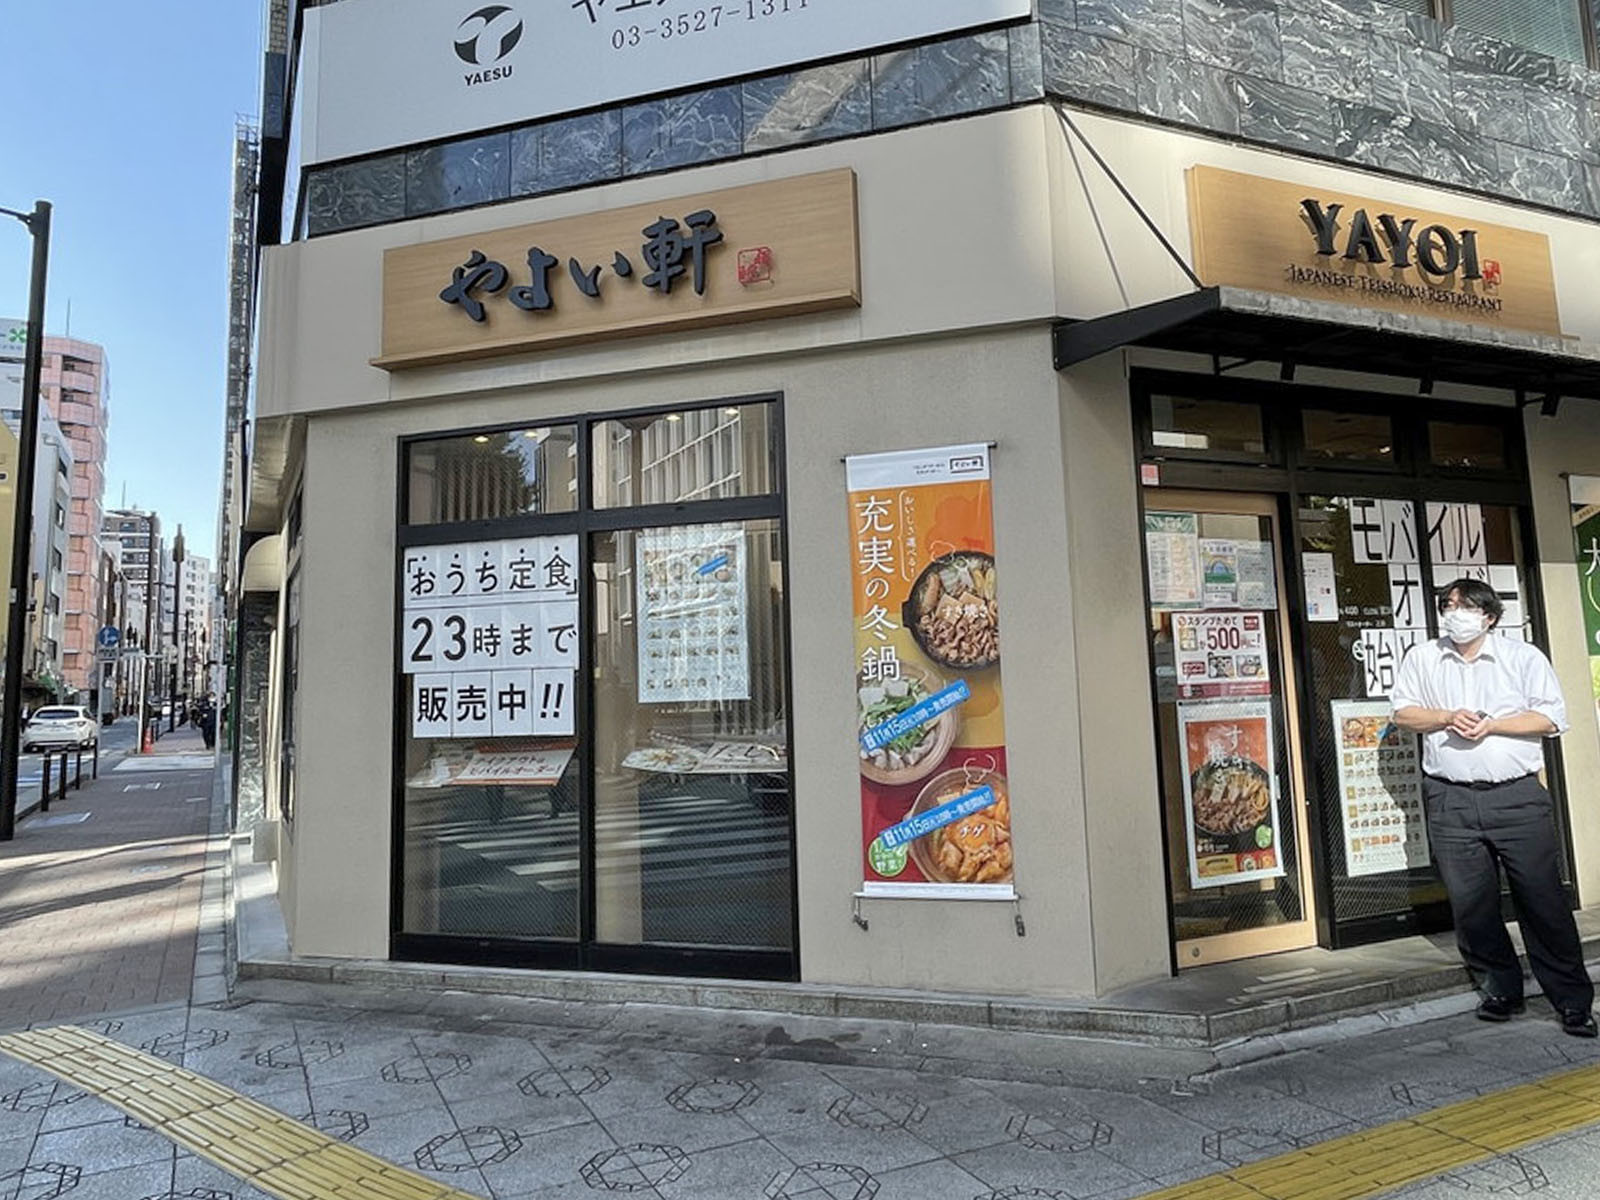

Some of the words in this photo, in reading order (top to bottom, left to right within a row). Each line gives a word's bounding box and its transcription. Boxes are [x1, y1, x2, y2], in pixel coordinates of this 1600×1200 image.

[464, 65, 513, 86] YAESU
[439, 209, 724, 322] やよい軒
[1300, 198, 1483, 281] YAYOI
[1287, 263, 1355, 287] JAPANESE
[1429, 287, 1503, 312] RESTAURANT
[1352, 500, 1481, 563] モバイル
[856, 496, 900, 682] 充実の冬鍋
[410, 614, 577, 662] 23時まで
[416, 682, 565, 723] 販売中!!
